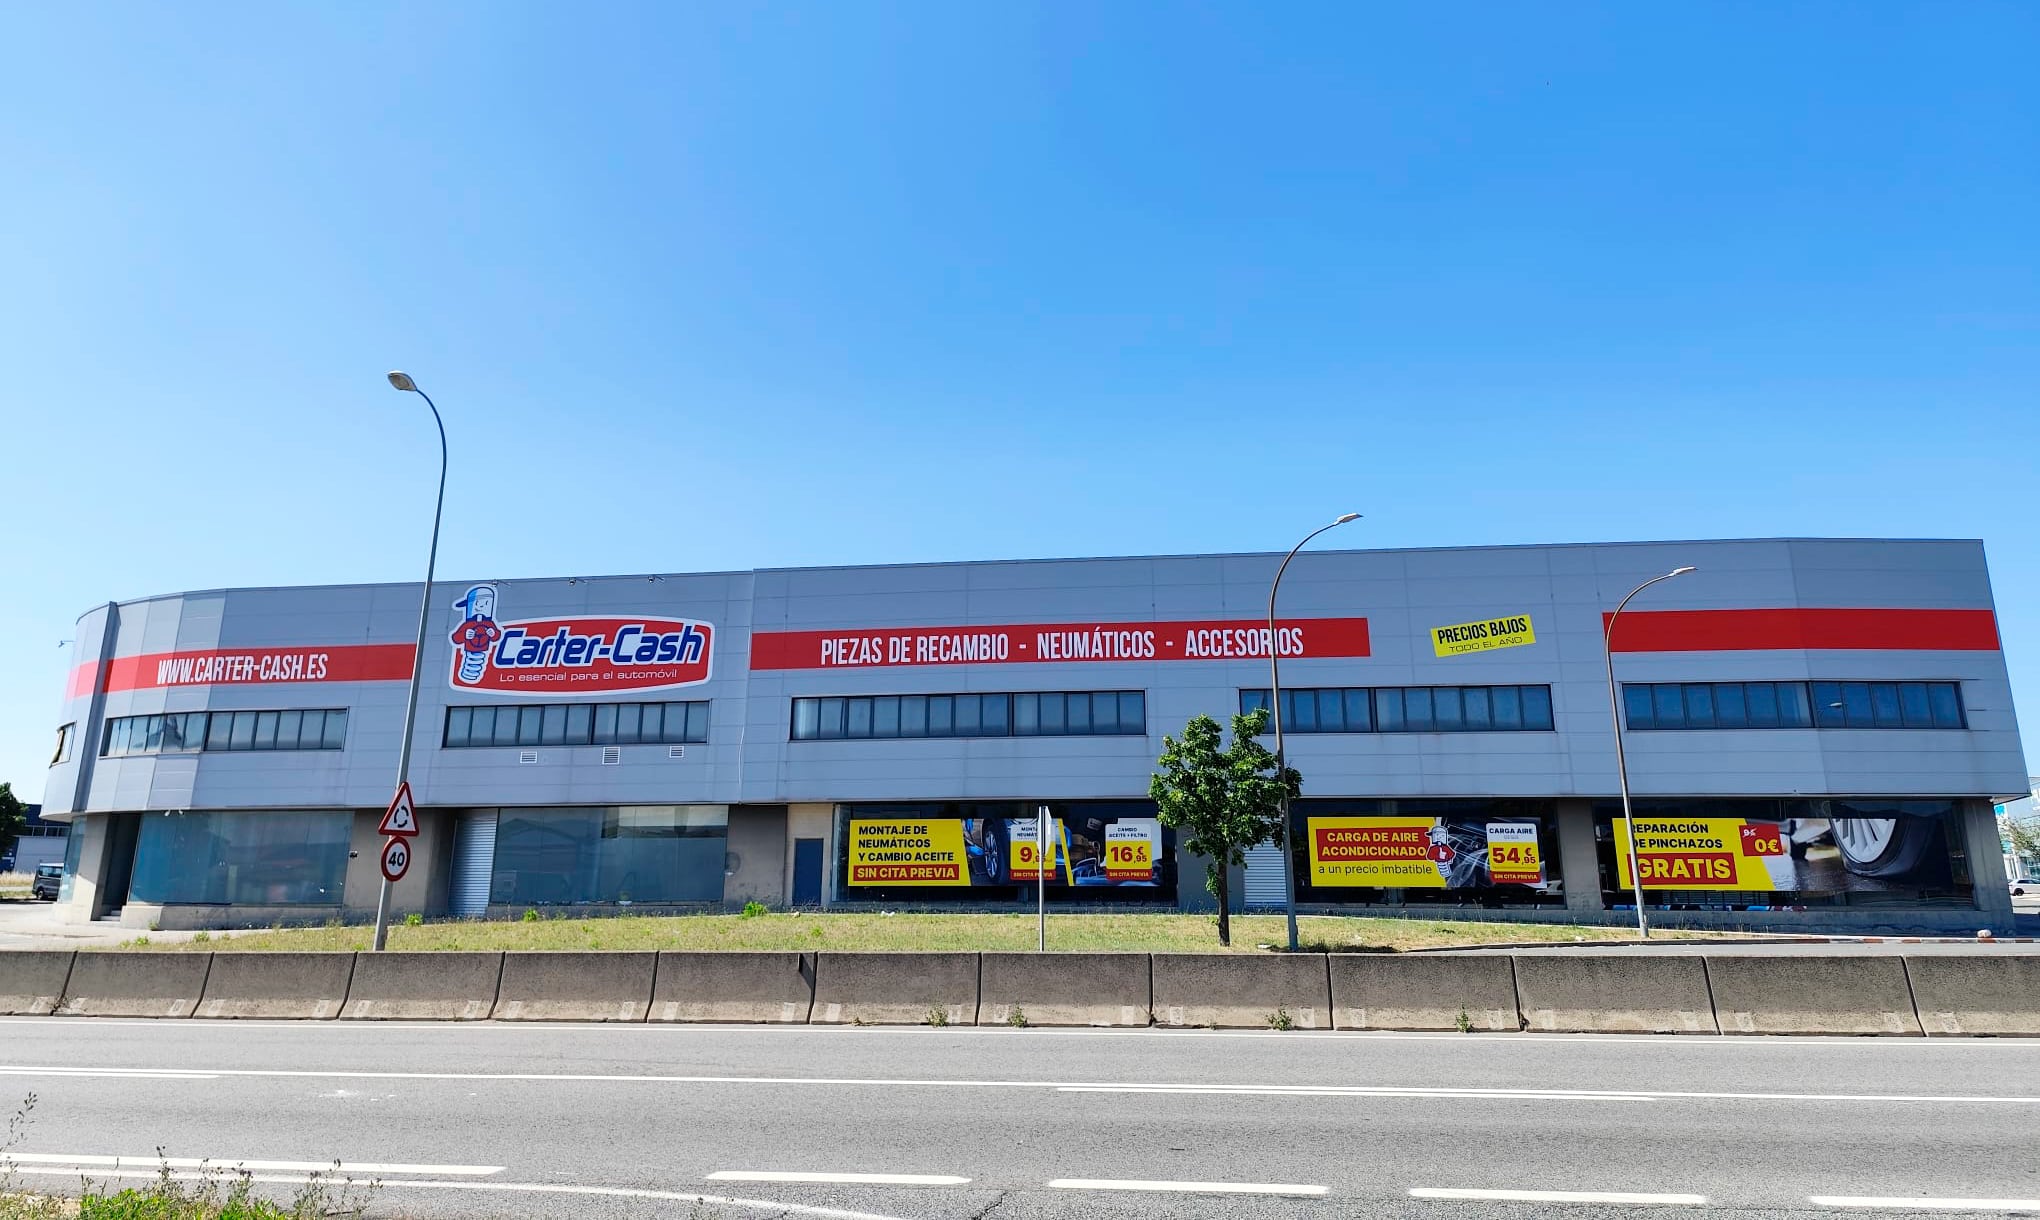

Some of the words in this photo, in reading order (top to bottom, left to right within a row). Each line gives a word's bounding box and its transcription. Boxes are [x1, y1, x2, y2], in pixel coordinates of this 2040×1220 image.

[1437, 623, 1488, 645] PRECIOS
[1489, 617, 1527, 637] BAJOS
[495, 624, 704, 666] Carter-Cash
[820, 637, 883, 666] PIEZAS
[888, 636, 912, 664] DE
[916, 633, 1009, 663] RECAMBIO
[1036, 626, 1155, 660] NEUMÁTICOS
[1185, 627, 1304, 657] ACCESORIOS
[1448, 642, 1480, 653] TODO
[1482, 641, 1496, 649] EL
[1499, 636, 1523, 646] AÑO
[156, 653, 329, 685] WWW.CARTER-CASH.ES
[499, 672, 514, 682] Lo
[518, 671, 567, 682] esencial
[570, 672, 599, 683] para
[603, 670, 613, 680] el
[617, 668, 677, 680] automóvil
[858, 825, 911, 835] MONTAJE
[913, 825, 928, 835] DE
[1326, 832, 1370, 842] CARGA
[1372, 832, 1389, 842] DE
[1391, 832, 1419, 842] AIRE
[858, 836, 931, 848] NEUMÁTICOS
[1648, 838, 1723, 849] PINCHAZOS
[1754, 838, 1779, 853] 0€
[387, 851, 405, 867] 40
[858, 852, 865, 862] Y
[867, 852, 912, 861] CAMBIO
[914, 852, 954, 861] ACEITE
[1321, 846, 1427, 857] ACONDICIONADO
[857, 867, 877, 878] SIN
[879, 867, 908, 878] CITA
[910, 867, 955, 878] PREVIA
[1318, 865, 1325, 874] a
[1328, 865, 1342, 874] un
[1345, 863, 1379, 876] precio
[1381, 863, 1433, 874] imbatible
[1638, 858, 1731, 880] GRATIS
